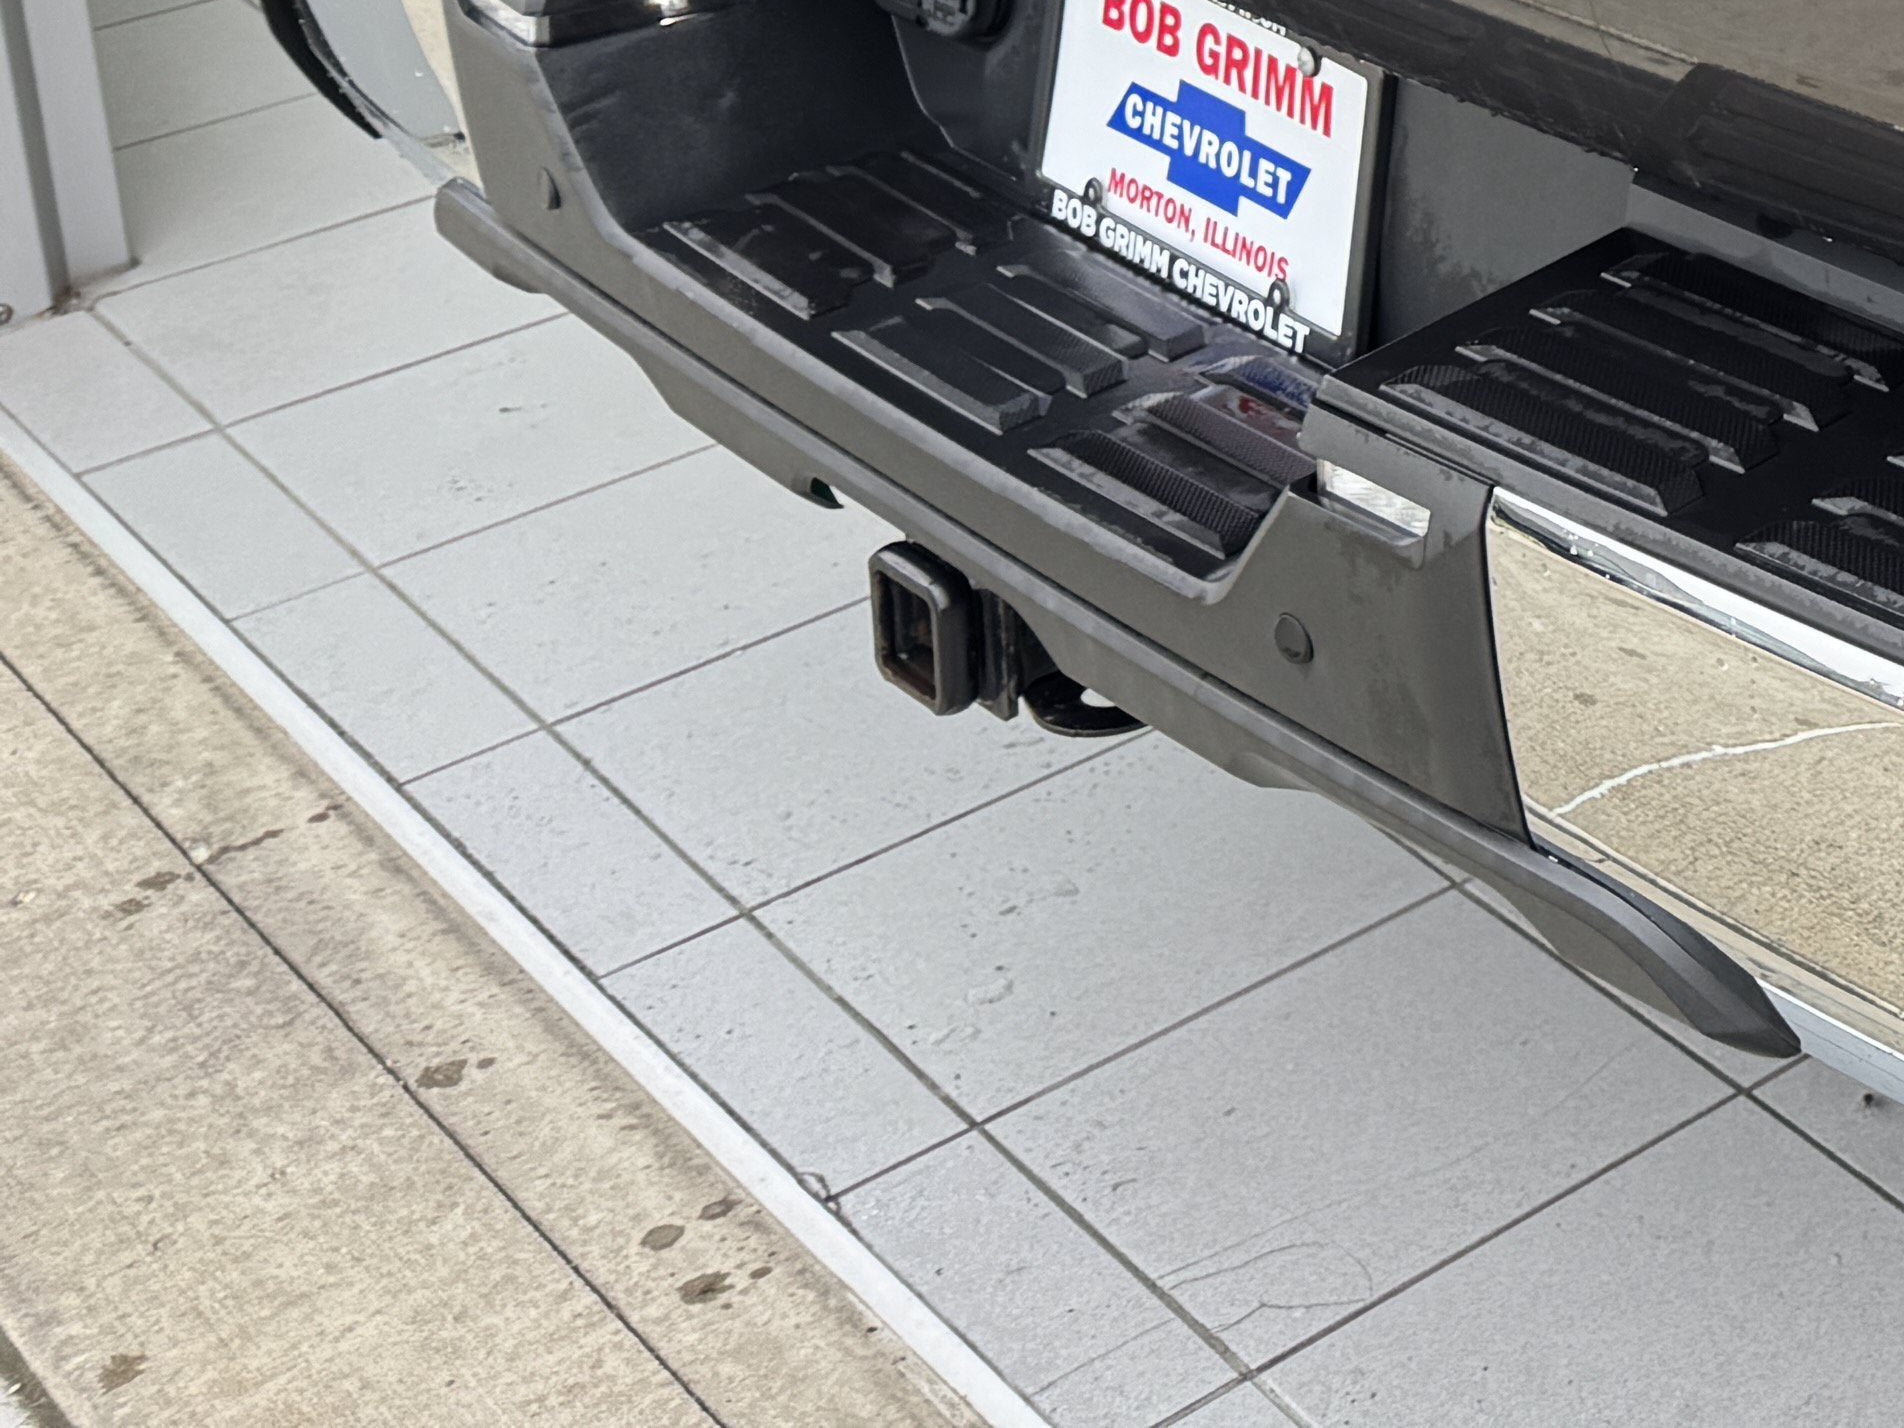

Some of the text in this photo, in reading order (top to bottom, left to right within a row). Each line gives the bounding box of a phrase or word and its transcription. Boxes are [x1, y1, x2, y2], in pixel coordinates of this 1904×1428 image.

[1195, 22, 1334, 139] GRIMM
[1124, 92, 1293, 205] CHEVROLET
[1050, 188, 1311, 354] BOB GRIMM CHEVROLET
[1107, 167, 1290, 282] MORTON, ILLINOIS
